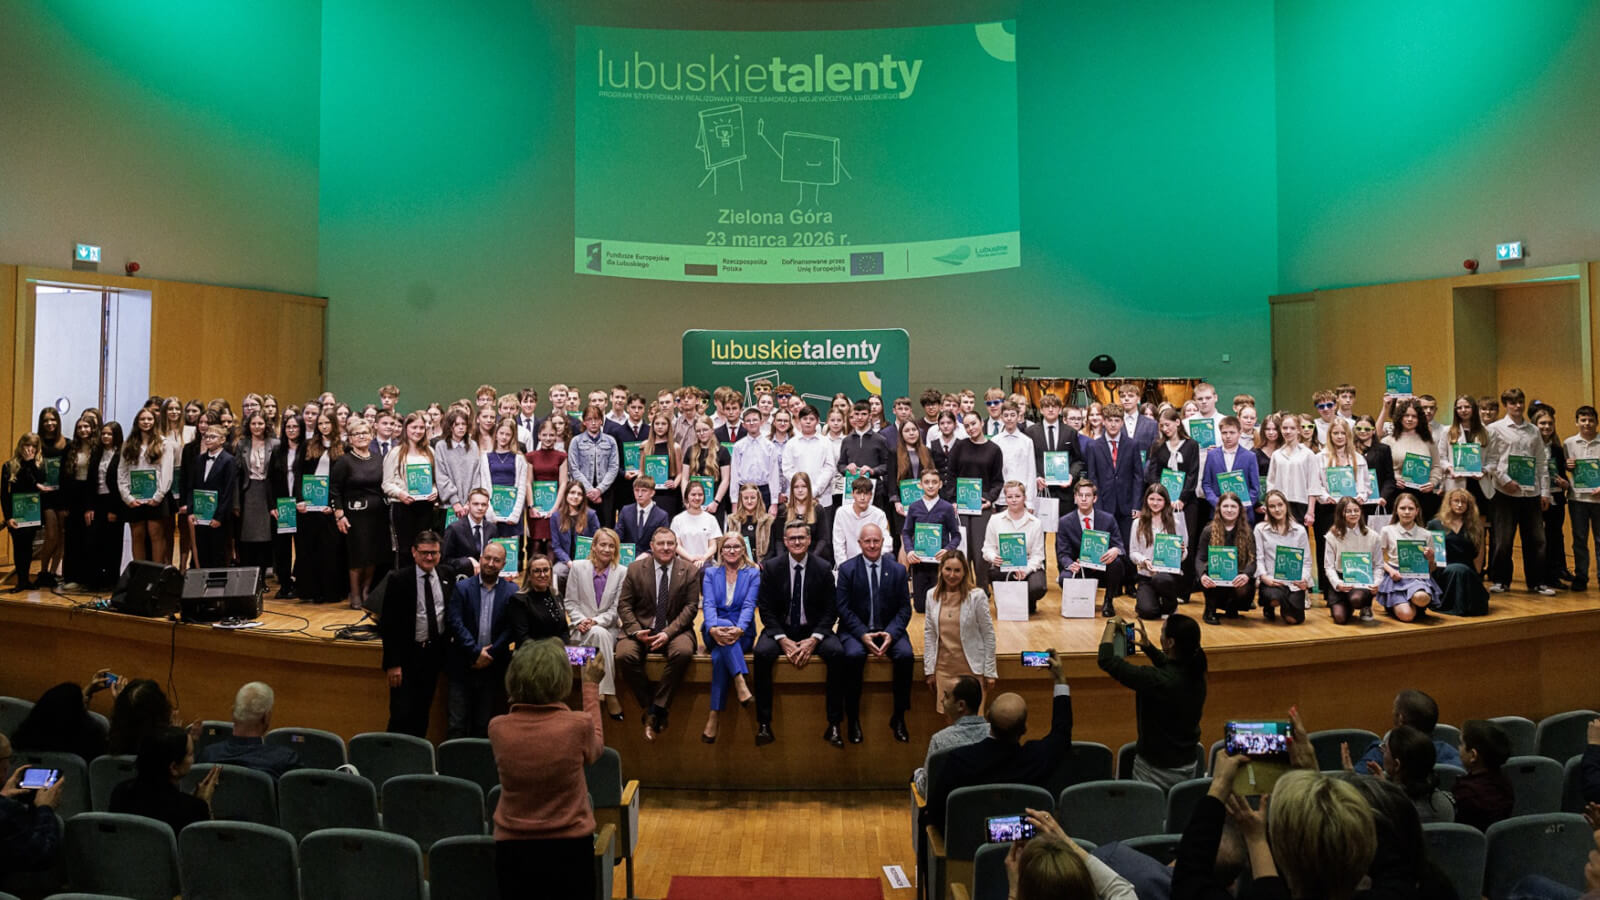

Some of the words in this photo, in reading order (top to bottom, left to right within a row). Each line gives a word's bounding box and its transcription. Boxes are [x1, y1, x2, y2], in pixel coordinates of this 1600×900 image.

[598, 50, 923, 99] lubuskietalenty
[718, 209, 783, 224] Zielona
[789, 209, 833, 224] Góra
[706, 232, 726, 246] 23
[732, 234, 787, 247] marca
[793, 232, 834, 246] 2026
[840, 233, 850, 246] r.
[606, 251, 633, 259] Fundusze
[635, 253, 670, 262] Europejskie
[722, 258, 767, 266] Rzeczpospolita
[829, 258, 845, 266] przez
[616, 260, 649, 268] Lubuskiego
[711, 339, 881, 363] lubuskietalenty
